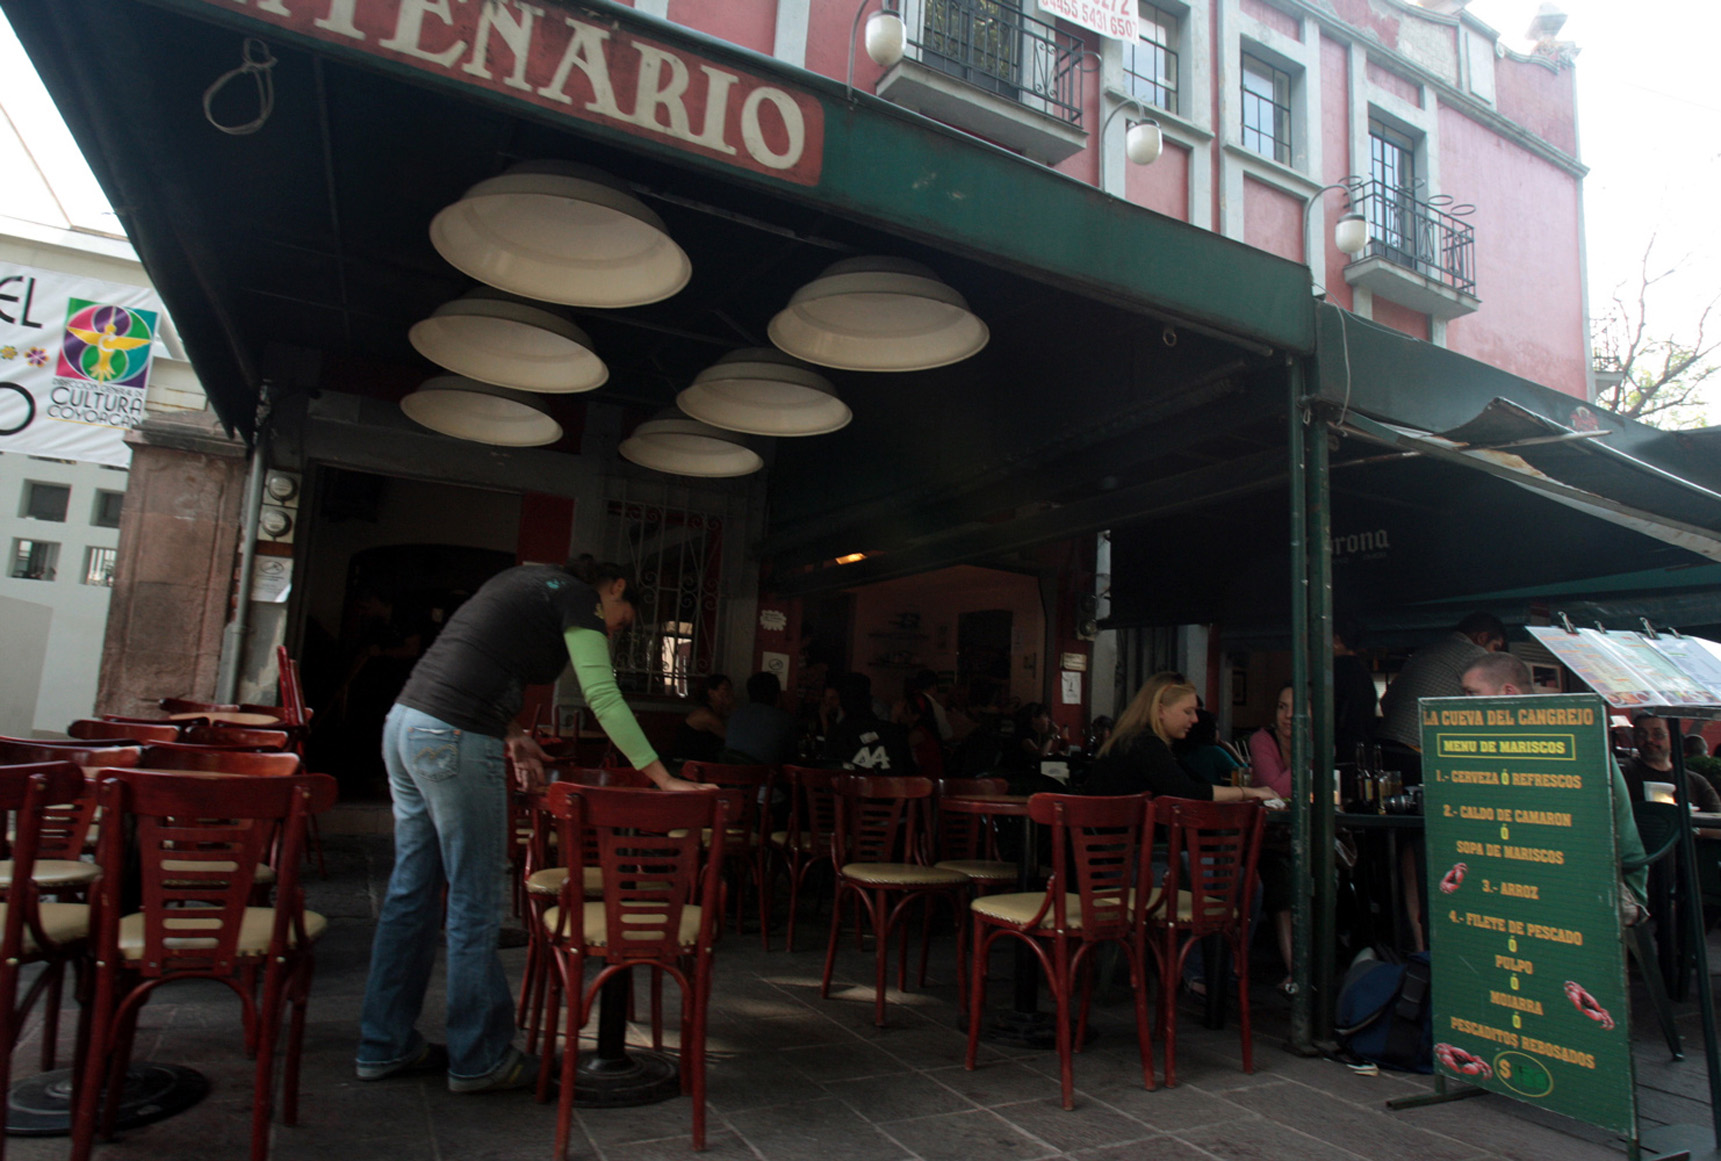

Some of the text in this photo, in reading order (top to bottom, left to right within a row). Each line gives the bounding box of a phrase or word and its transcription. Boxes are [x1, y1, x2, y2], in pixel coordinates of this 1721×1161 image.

[1082, 3, 1108, 32] 5431
[215, 0, 805, 170] ENARIO
[51, 386, 142, 414] CULTURA
[47, 405, 141, 426] COYOACAN
[1331, 529, 1390, 555] rona
[1424, 708, 1594, 726] LA CUEVA DEL CANGREJO
[1444, 741, 1566, 754] MENU DE MARISCOS
[1452, 770, 1500, 785] CERVEZA
[1512, 773, 1582, 789] REFRESCOS
[1460, 806, 1494, 820] CALDO
[1496, 809, 1513, 822] DE
[1515, 810, 1572, 827] CAMARON
[1457, 841, 1564, 864] SOPA DE MARISCOS
[1501, 883, 1539, 899] ARROZ
[1466, 913, 1506, 932] FILETE
[1508, 921, 1525, 935] DE
[1527, 924, 1583, 946] PESCADO
[1496, 955, 1533, 975] PULPO
[1450, 1016, 1595, 1069] PESCADITOS REBOSADOS
